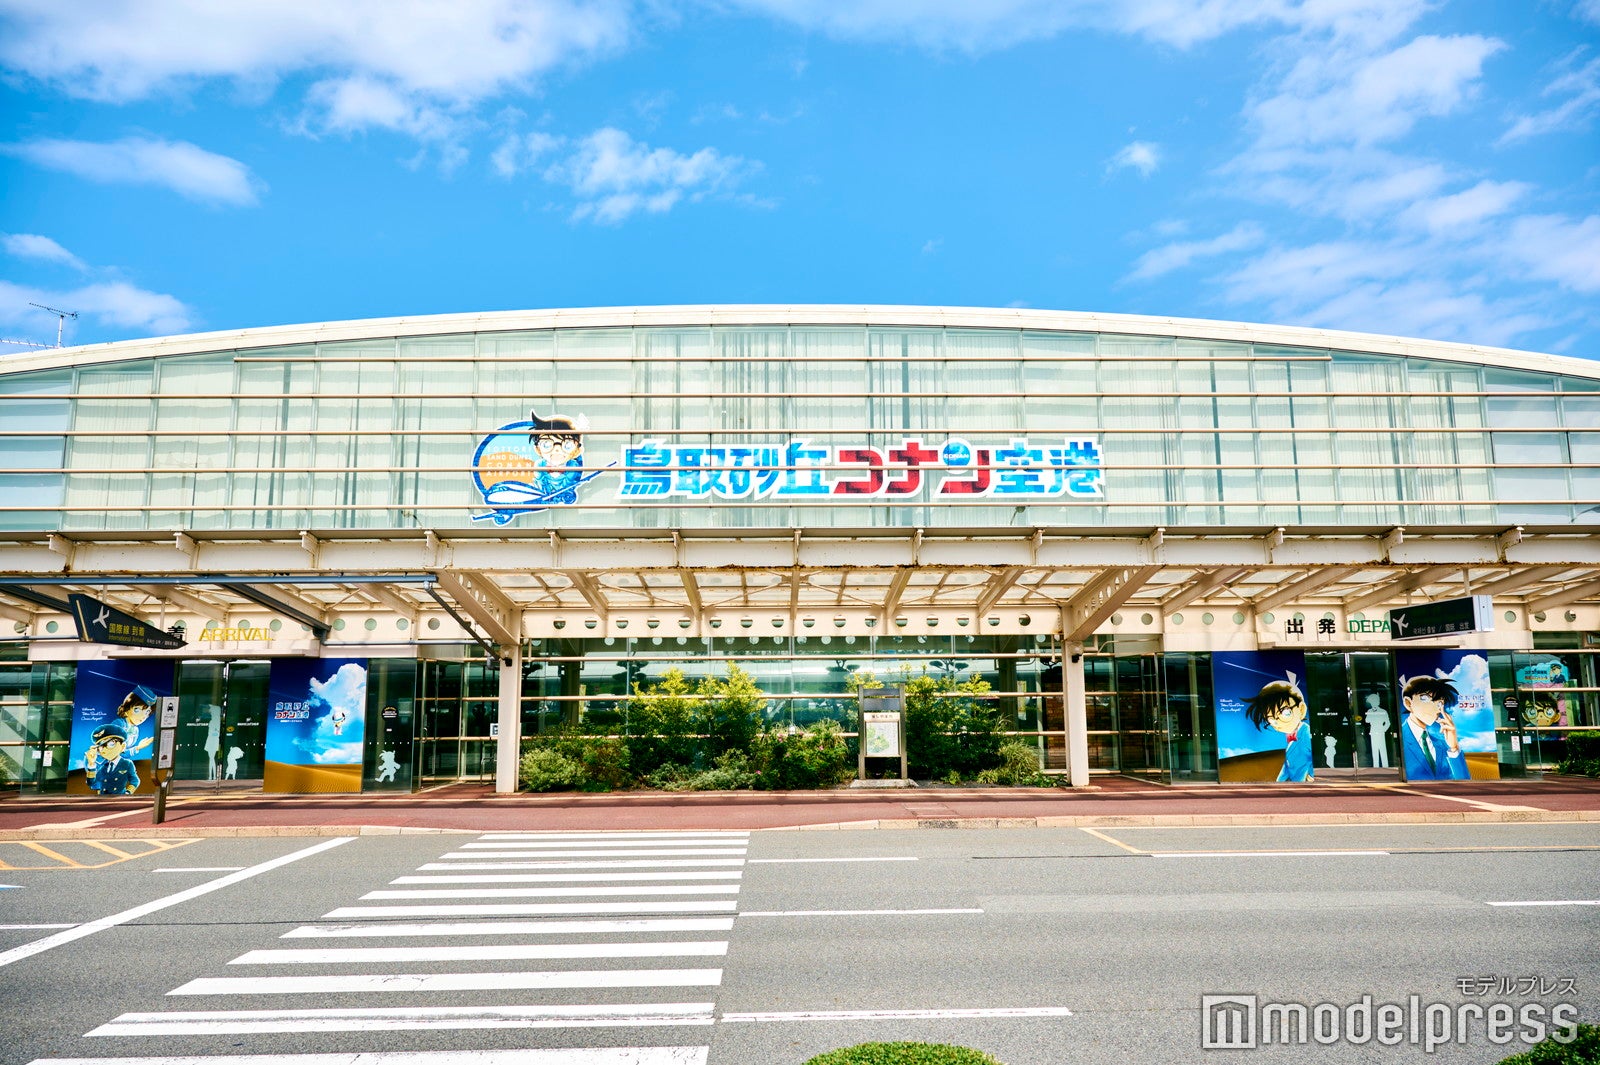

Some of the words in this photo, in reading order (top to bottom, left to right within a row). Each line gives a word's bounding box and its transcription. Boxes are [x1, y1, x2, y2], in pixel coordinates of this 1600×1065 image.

[621, 440, 1101, 496] 鳥取砂丘コナン空港
[198, 627, 273, 641] ARRIVAL
